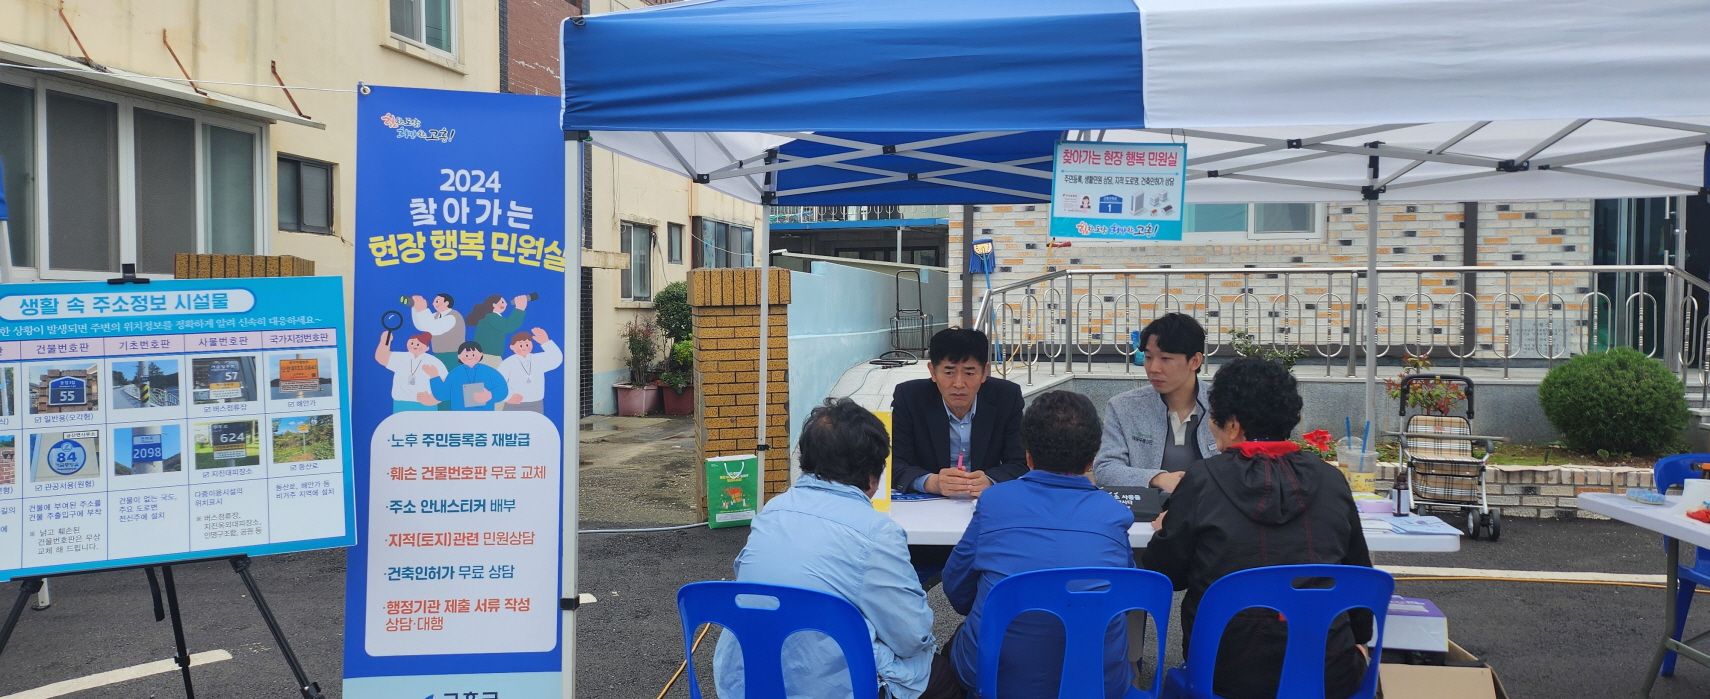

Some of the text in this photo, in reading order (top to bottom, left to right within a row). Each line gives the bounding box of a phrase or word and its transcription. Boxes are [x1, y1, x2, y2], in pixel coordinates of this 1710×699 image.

[1063, 149, 1178, 167] 찾아가는 현장 행복 민원실
[440, 168, 501, 193] 2024
[1108, 204, 1112, 213] 1
[368, 230, 565, 272] 현장 행복 민원실
[20, 293, 228, 316] 생활 속 주소정보 시설물
[13, 325, 44, 336] 상황이
[46, 324, 88, 335] 발생되면
[90, 322, 120, 332] 주변의
[124, 320, 172, 331] 위치정보를
[176, 320, 214, 330] 정확하게
[216, 318, 236, 328] 알려
[240, 316, 266, 328] 신속히
[198, 336, 248, 347] 사물번호판
[270, 332, 328, 344] 국가지점번호판
[36, 343, 88, 354] 건물번호판
[120, 340, 170, 351] 기초번호판
[226, 372, 238, 380] 57
[60, 391, 74, 402] 55
[44, 413, 94, 424] 일반용(오각형)
[220, 432, 245, 442] 624
[422, 434, 488, 448] 주민등록증
[492, 432, 530, 446] 재발급
[56, 452, 78, 462] 84
[134, 448, 162, 458] 2098
[422, 466, 488, 481] 건물번호판
[491, 466, 516, 480] 무료
[520, 466, 546, 480] 교체
[46, 480, 95, 492] 관공서용(원형)
[29, 499, 101, 512] 건물에 부여된 주소를
[420, 499, 486, 514] 안내스티커
[490, 498, 516, 513] 배부
[29, 513, 43, 522] 건물
[482, 532, 535, 546] 민원상담
[458, 566, 484, 580] 무료
[488, 564, 515, 580] 상담
[444, 599, 470, 614] 제출
[474, 598, 500, 613] 서류
[504, 598, 530, 612] 작성
[386, 617, 444, 632] 상담·대행
